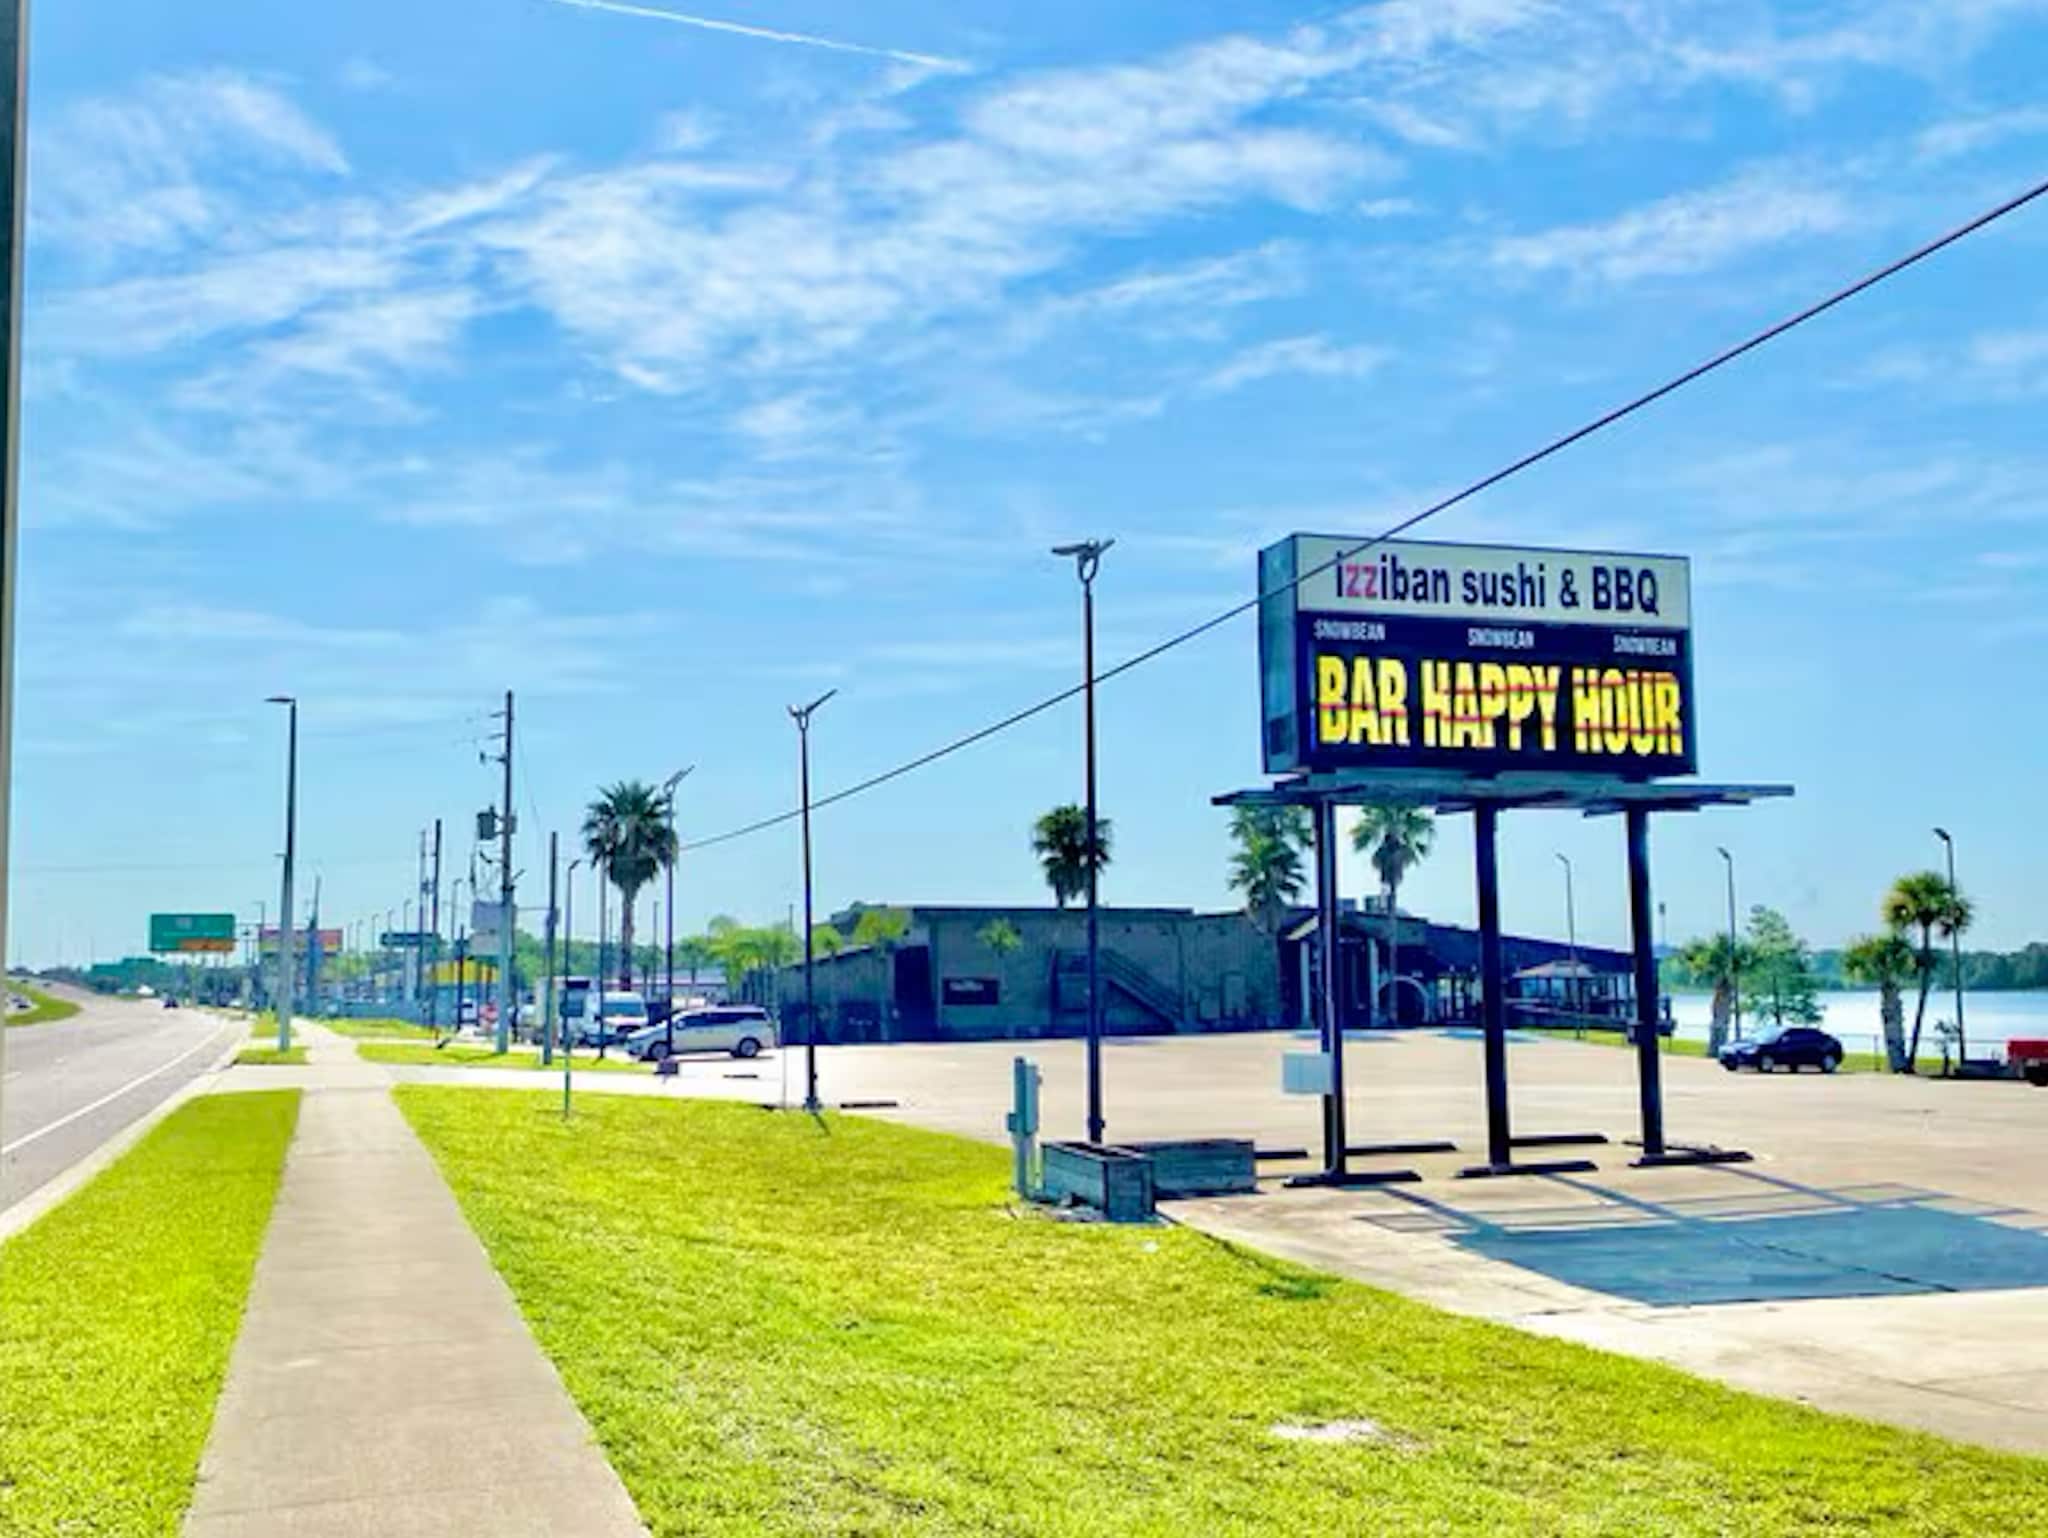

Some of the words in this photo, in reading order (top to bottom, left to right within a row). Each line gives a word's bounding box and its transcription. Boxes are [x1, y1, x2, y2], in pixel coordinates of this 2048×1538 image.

[1336, 551, 1450, 604] izziban
[1462, 563, 1546, 608] sushi
[1560, 568, 1580, 609] &
[1592, 566, 1660, 615] BBQ
[1317, 655, 1411, 747] BAR
[1421, 658, 1561, 751] HAPPY
[1572, 667, 1684, 757] HOUR
